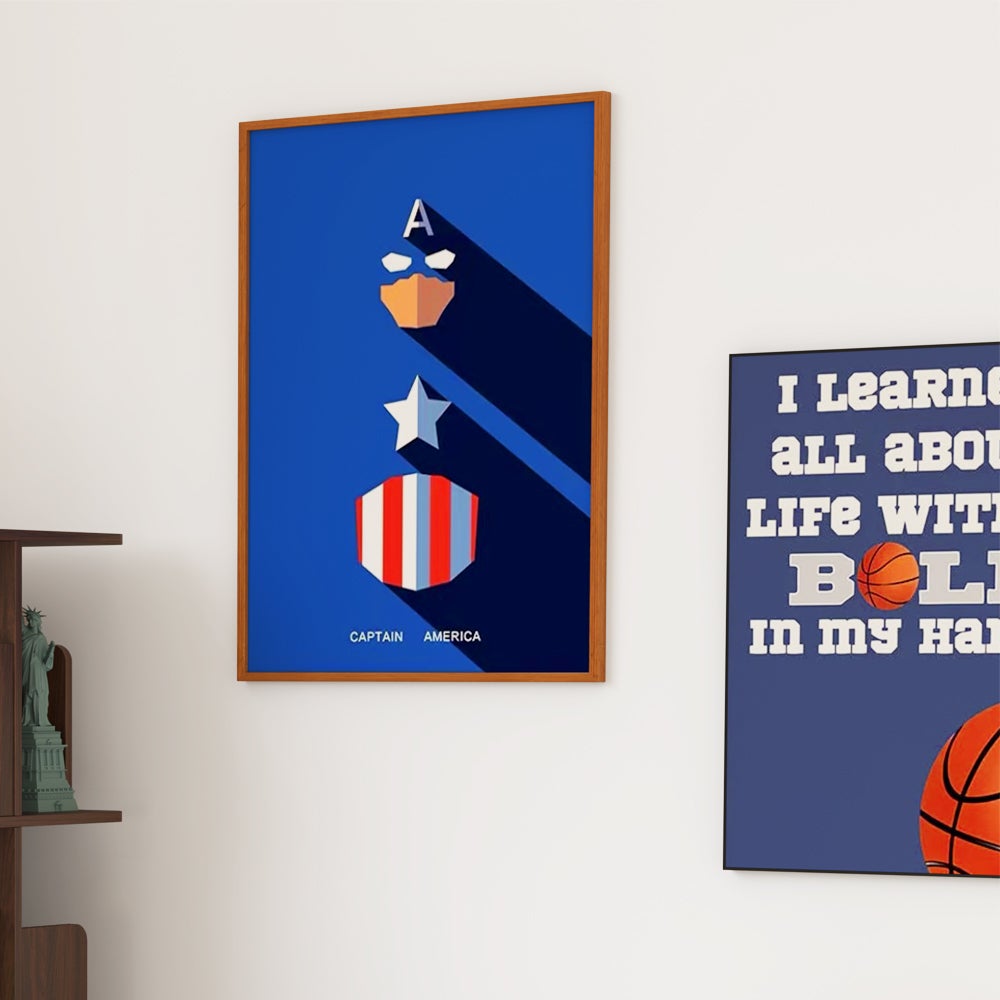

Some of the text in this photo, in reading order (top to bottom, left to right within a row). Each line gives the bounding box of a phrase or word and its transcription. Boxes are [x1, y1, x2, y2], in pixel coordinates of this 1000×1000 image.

[403, 198, 434, 237] A
[777, 374, 799, 413] I
[876, 491, 1000, 535] WIT
[349, 630, 482, 643] CAPTAIN AMERICA
